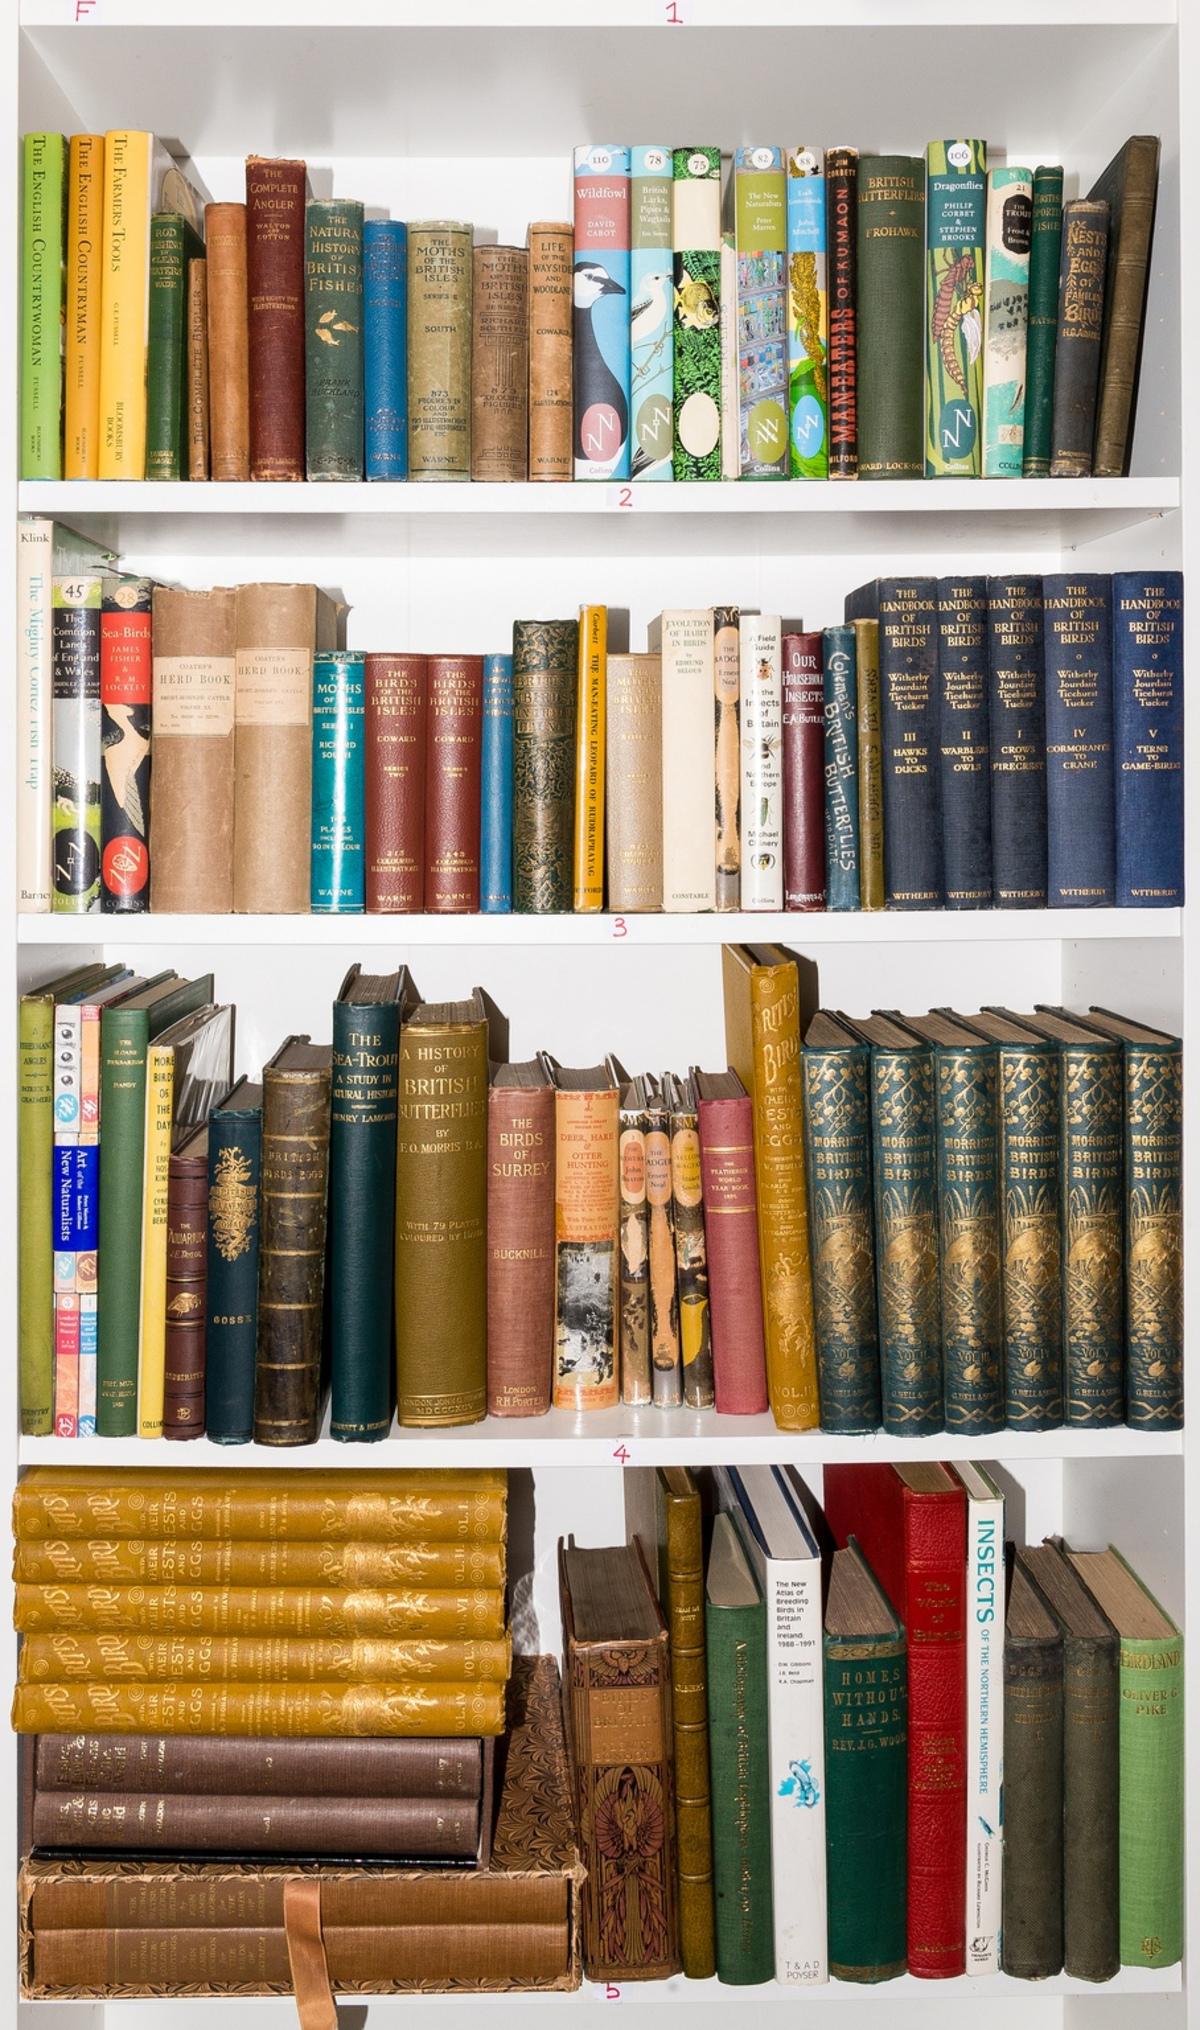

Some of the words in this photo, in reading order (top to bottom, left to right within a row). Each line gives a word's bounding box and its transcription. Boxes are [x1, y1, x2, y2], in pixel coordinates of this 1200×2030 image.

[75, 1, 95, 21] F
[666, 2, 684, 24] 1
[33, 136, 46, 165] THE
[80, 138, 92, 168] THE
[950, 150, 969, 160] 106
[649, 155, 662, 165] 78
[693, 161, 706, 170] 75
[263, 169, 283, 178] THE
[868, 177, 915, 188] BRITISH
[934, 182, 983, 192] Dragonflies
[250, 183, 298, 194] COMPLETE
[577, 187, 626, 199] Wildfowl
[33, 171, 46, 232] ENGLISH
[78, 173, 92, 234] ENGLISH
[253, 200, 295, 210] ANGLER
[327, 215, 348, 224] THE
[588, 220, 615, 228] DAVID
[586, 228, 616, 237] CABOT
[837, 188, 848, 270] KUMAON
[866, 227, 919, 238] FROHAWK
[939, 226, 977, 234] STEPHEN
[111, 228, 126, 272] TOOLS
[416, 247, 465, 257] MOTHS
[541, 243, 565, 251] LIFE
[415, 266, 465, 275] BRITISH
[533, 264, 572, 273] WAYSIDE
[424, 275, 458, 283] ISLES
[77, 240, 92, 345] COUNTRYMAN
[837, 276, 848, 299] OF
[32, 239, 46, 367] COUNTRYWOMAN
[831, 308, 856, 443] MAN-EATERS
[619, 488, 632, 507] 2
[21, 533, 50, 543] Klink
[65, 584, 85, 598] 45
[896, 589, 918, 598] THE
[119, 592, 134, 602] 28
[880, 601, 935, 612] HANDBOOK
[1044, 598, 1105, 609] HANDBOOK
[902, 614, 915, 623] OF
[885, 625, 931, 636] BRITISH
[1053, 622, 1099, 632] BRITISH
[102, 627, 151, 638] Sea-Birds
[892, 637, 926, 647] BIRDS
[1060, 634, 1095, 644] BIRDS
[792, 652, 817, 669] OUR
[160, 674, 192, 684] HERD
[199, 674, 232, 684] BOOK
[888, 673, 930, 683] Witherby
[1057, 670, 1099, 681] Witherby
[375, 679, 417, 688] BIRDS
[434, 680, 475, 688] BIRDS
[889, 683, 928, 691] Jourdain
[784, 688, 824, 703] INSECTS
[889, 692, 929, 700] Ticehurst
[371, 696, 421, 706] BRITISH
[430, 697, 479, 706] BRITISH
[894, 702, 925, 710] Tucker
[1064, 699, 1094, 708] Tucker
[377, 707, 416, 716] ISLES
[435, 707, 474, 716] ISLES
[904, 733, 916, 741] III
[1073, 729, 1086, 738] IV
[1149, 730, 1158, 738] V
[824, 703, 856, 779] BRITISH
[893, 748, 928, 757] HAWKS
[1001, 746, 1035, 754] CROWS
[1136, 745, 1168, 753] TERNS
[895, 765, 928, 774] DUCKS
[954, 763, 981, 771] OWLS
[1063, 761, 1098, 769] CRANE
[1122, 762, 1181, 770] GAME-BIRDS
[825, 763, 856, 871] BUTTERFLIES
[893, 891, 938, 900] WITHERBY
[1059, 888, 1106, 897] WITHERBY
[613, 917, 628, 937] 3
[348, 1033, 382, 1046] THE
[402, 1049, 410, 1060] A
[418, 1045, 480, 1060] HISTORY
[154, 1056, 175, 1067] MORE
[434, 1064, 448, 1073] OF
[347, 1075, 378, 1084] STUDY
[382, 1074, 392, 1083] IN
[405, 1076, 478, 1095] BRITISH
[157, 1104, 170, 1114] THE
[156, 1120, 171, 1130] DAY
[512, 1119, 532, 1128] THE
[435, 1129, 450, 1137] BY
[500, 1133, 544, 1146] BIRDS
[421, 1142, 461, 1154] MORRIS
[77, 1150, 88, 1169] Art
[514, 1150, 528, 1159] OF
[61, 1150, 72, 1176] New
[567, 1161, 609, 1169] HUNTING
[493, 1162, 549, 1177] SURREY
[816, 1168, 862, 1180] BIRDS
[61, 1179, 73, 1241] Naturalists
[493, 1249, 545, 1260] BUCKNILL
[503, 1386, 536, 1394] LONDON
[613, 1444, 631, 1464] 4
[976, 1519, 995, 1623] INSECTS
[776, 1598, 809, 1606] Breeding
[980, 1629, 989, 1642] OF
[980, 1644, 989, 1666] THE
[842, 1669, 900, 1686] HOMES
[979, 1668, 989, 1725] NORTHERN
[1136, 1705, 1167, 1716] PIKE
[978, 1728, 989, 1794] HEMISPHERE
[794, 1962, 800, 1970] &
[804, 1961, 811, 1969] A
[786, 1970, 819, 1980] POYSER
